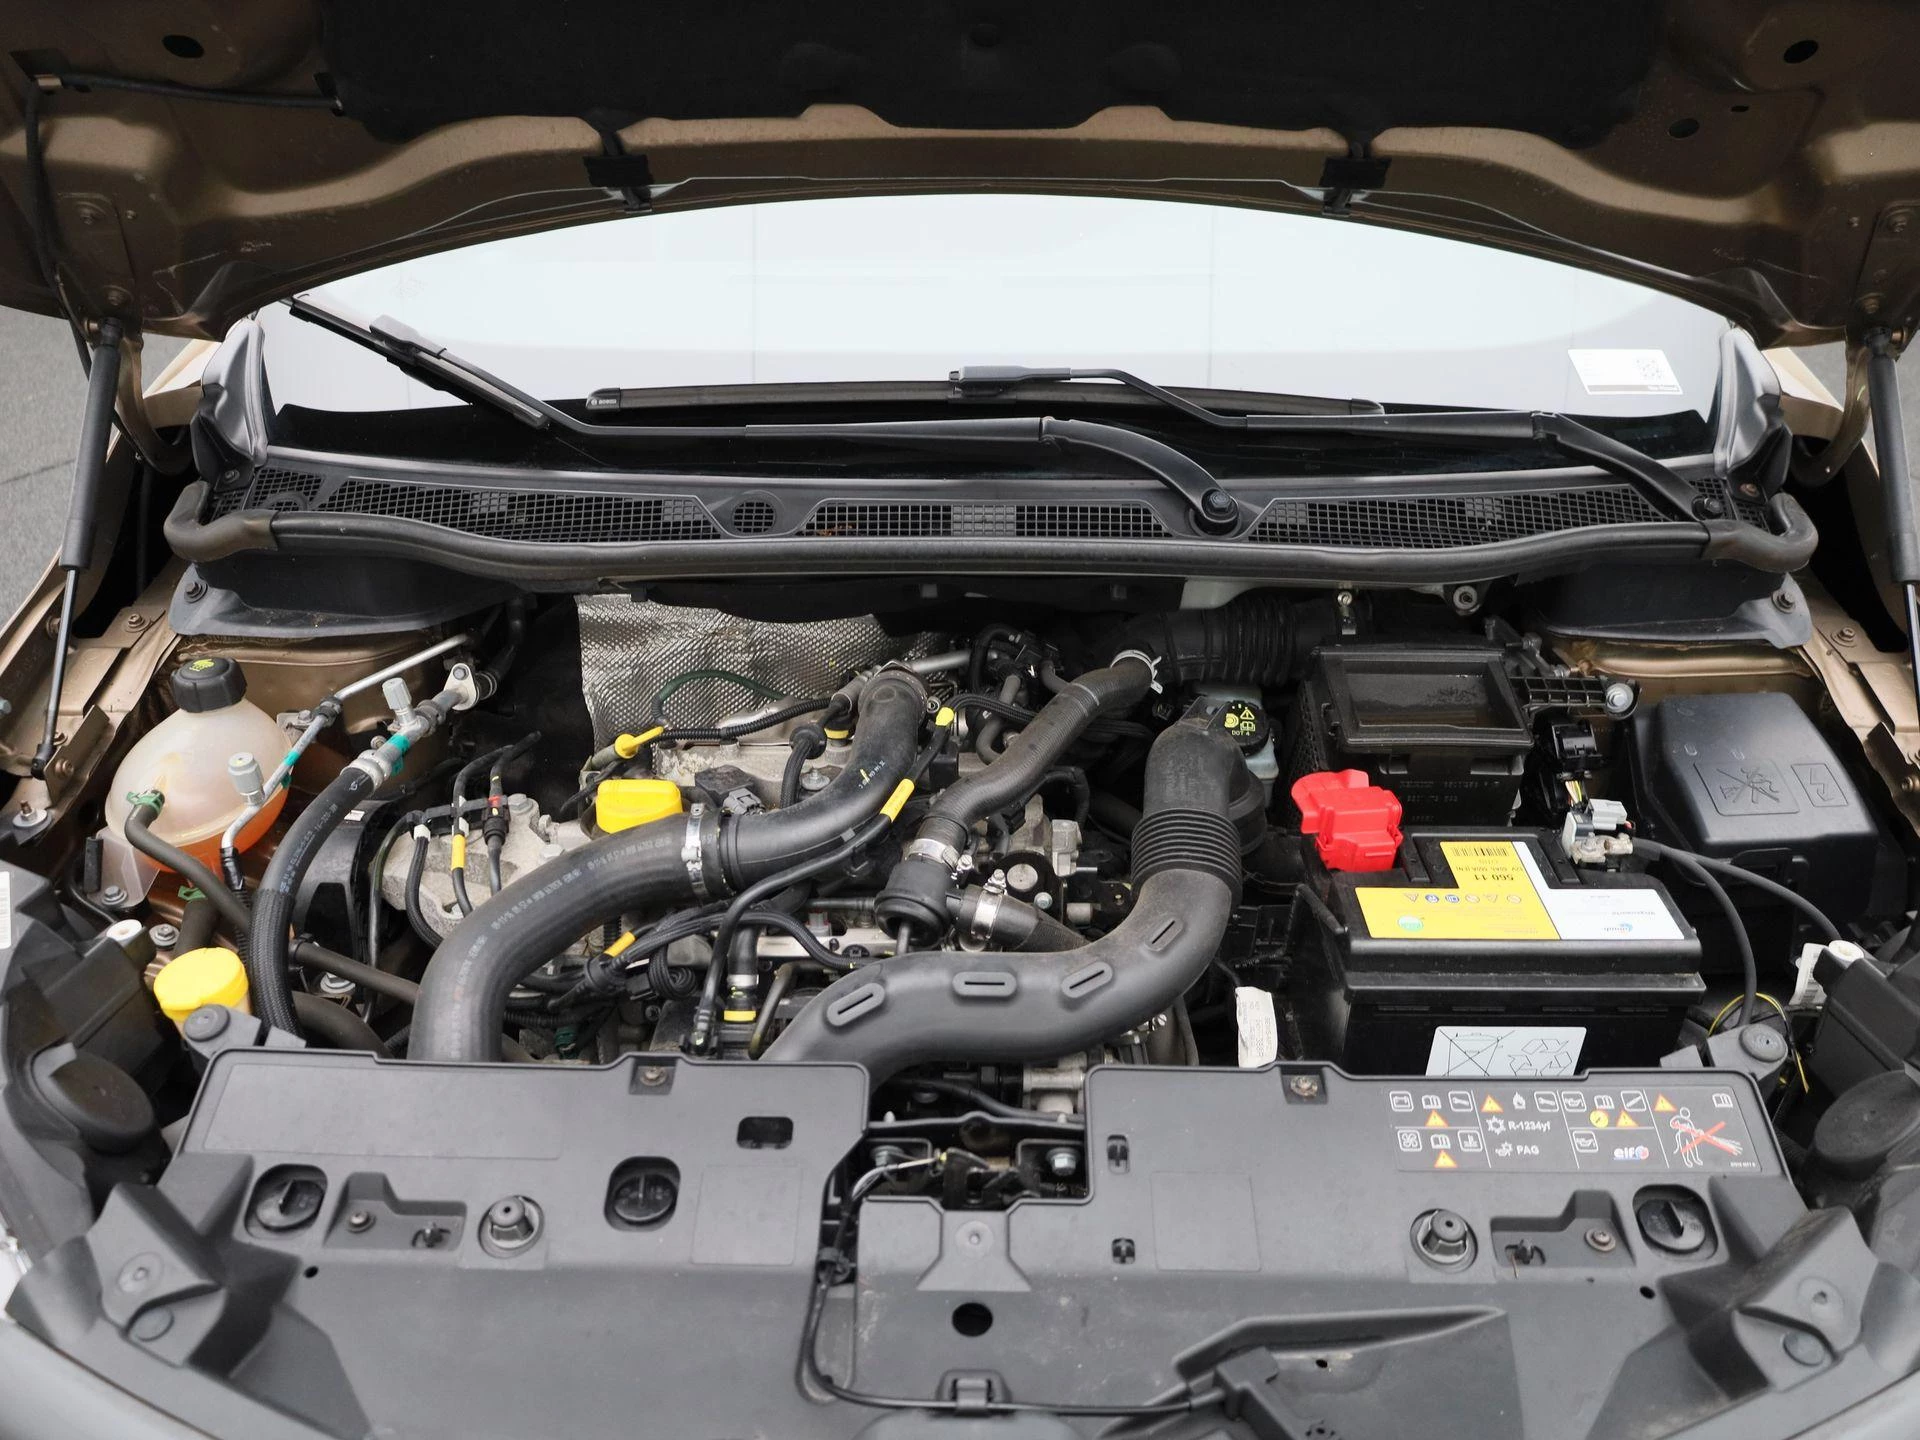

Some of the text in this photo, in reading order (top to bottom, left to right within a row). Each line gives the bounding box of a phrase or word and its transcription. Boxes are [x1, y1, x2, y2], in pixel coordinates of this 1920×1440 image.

[1473, 873, 1488, 881] 11
[1508, 1120, 1551, 1132] R-1234yf
[1516, 1143, 1540, 1155] PAG
[1613, 1146, 1637, 1159] elf
